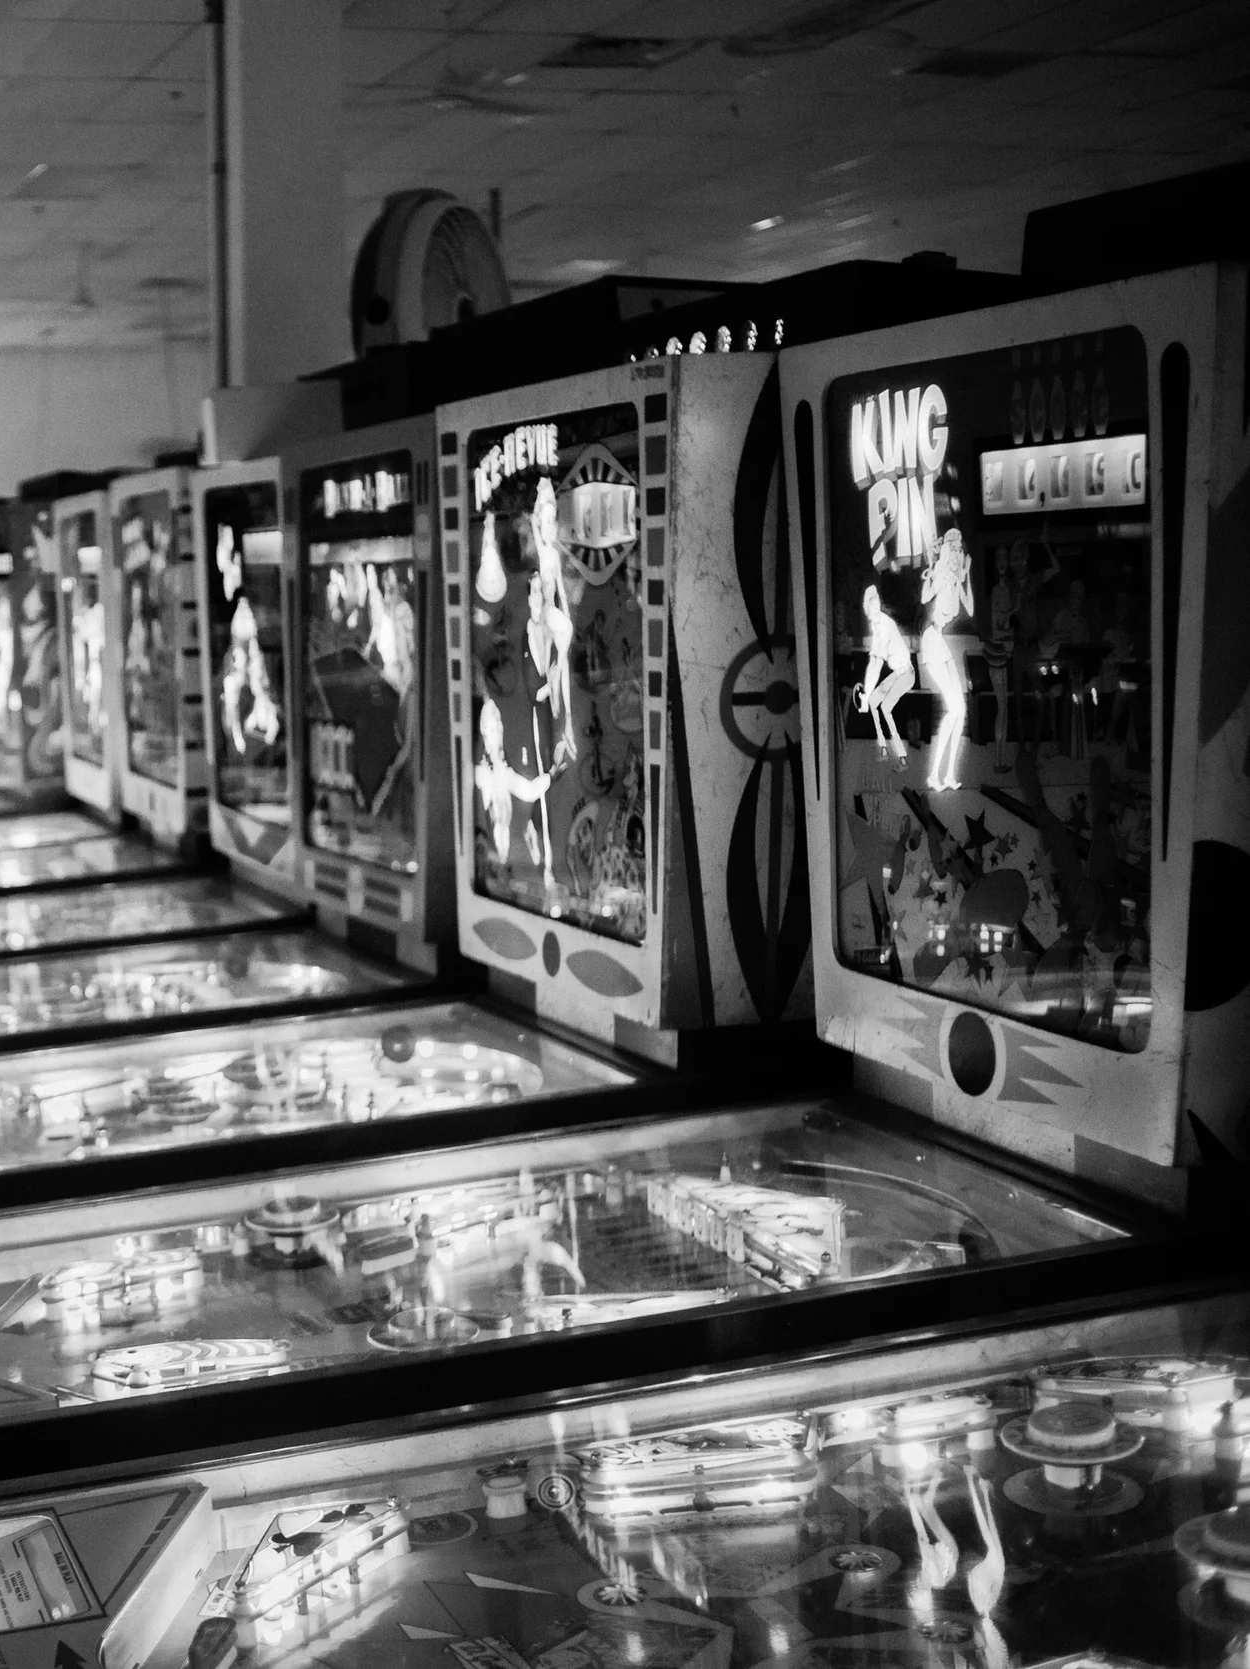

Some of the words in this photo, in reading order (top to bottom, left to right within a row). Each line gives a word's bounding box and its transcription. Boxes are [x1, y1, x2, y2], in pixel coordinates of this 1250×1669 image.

[851, 384, 949, 491] KING
[867, 472, 939, 570] PIN
[53, 1552, 64, 1565] BALL
[61, 1571, 74, 1584] PLAY
